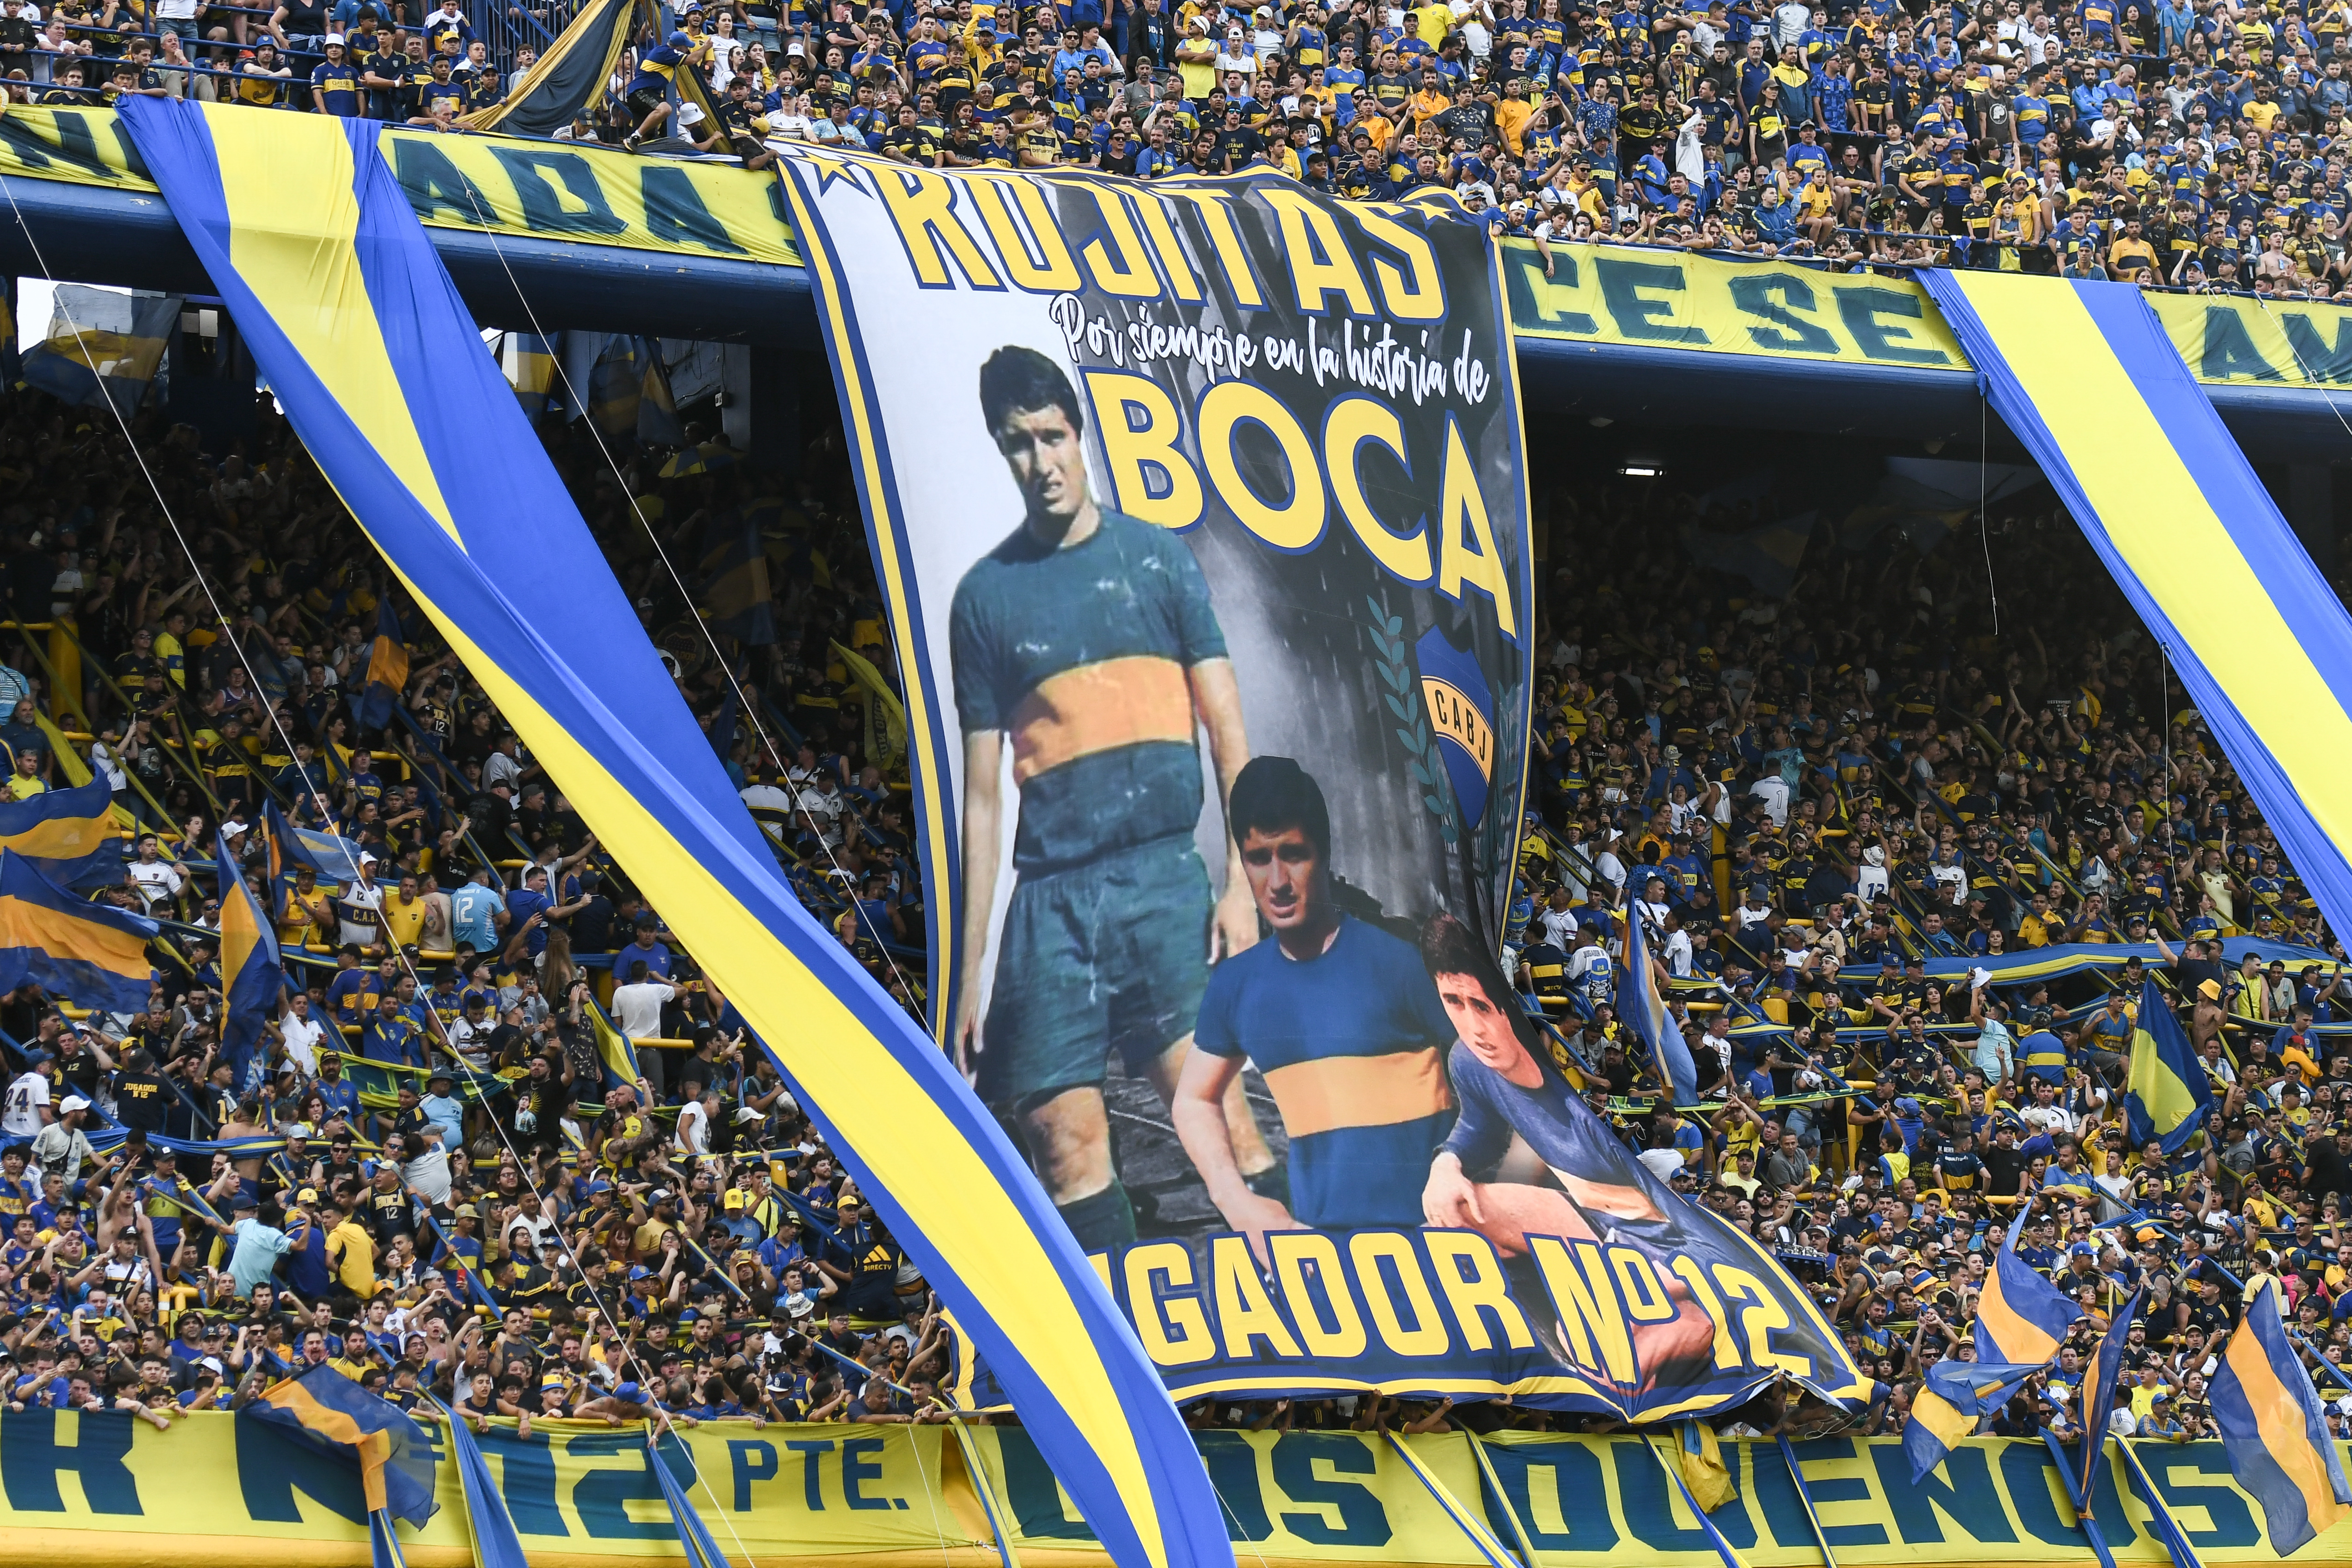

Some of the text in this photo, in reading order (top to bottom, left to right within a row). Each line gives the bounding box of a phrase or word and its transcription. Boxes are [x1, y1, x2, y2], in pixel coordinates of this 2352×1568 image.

[1049, 292, 1491, 407] Por siempre en la historia de
[1082, 370, 1520, 646] BOCA
[435, 721, 444, 732] 12
[1433, 688, 1489, 763] CABJ
[1776, 790, 1783, 810] 1
[356, 890, 365, 902] 12
[1866, 883, 1885, 901] 12
[455, 897, 474, 924] 12
[123, 1082, 158, 1093] JUGADOR
[5, 1087, 30, 1113] 24
[374, 1193, 405, 1209] BOCA
[385, 1206, 398, 1220] 12
[725, 1437, 912, 1513] PTE.
